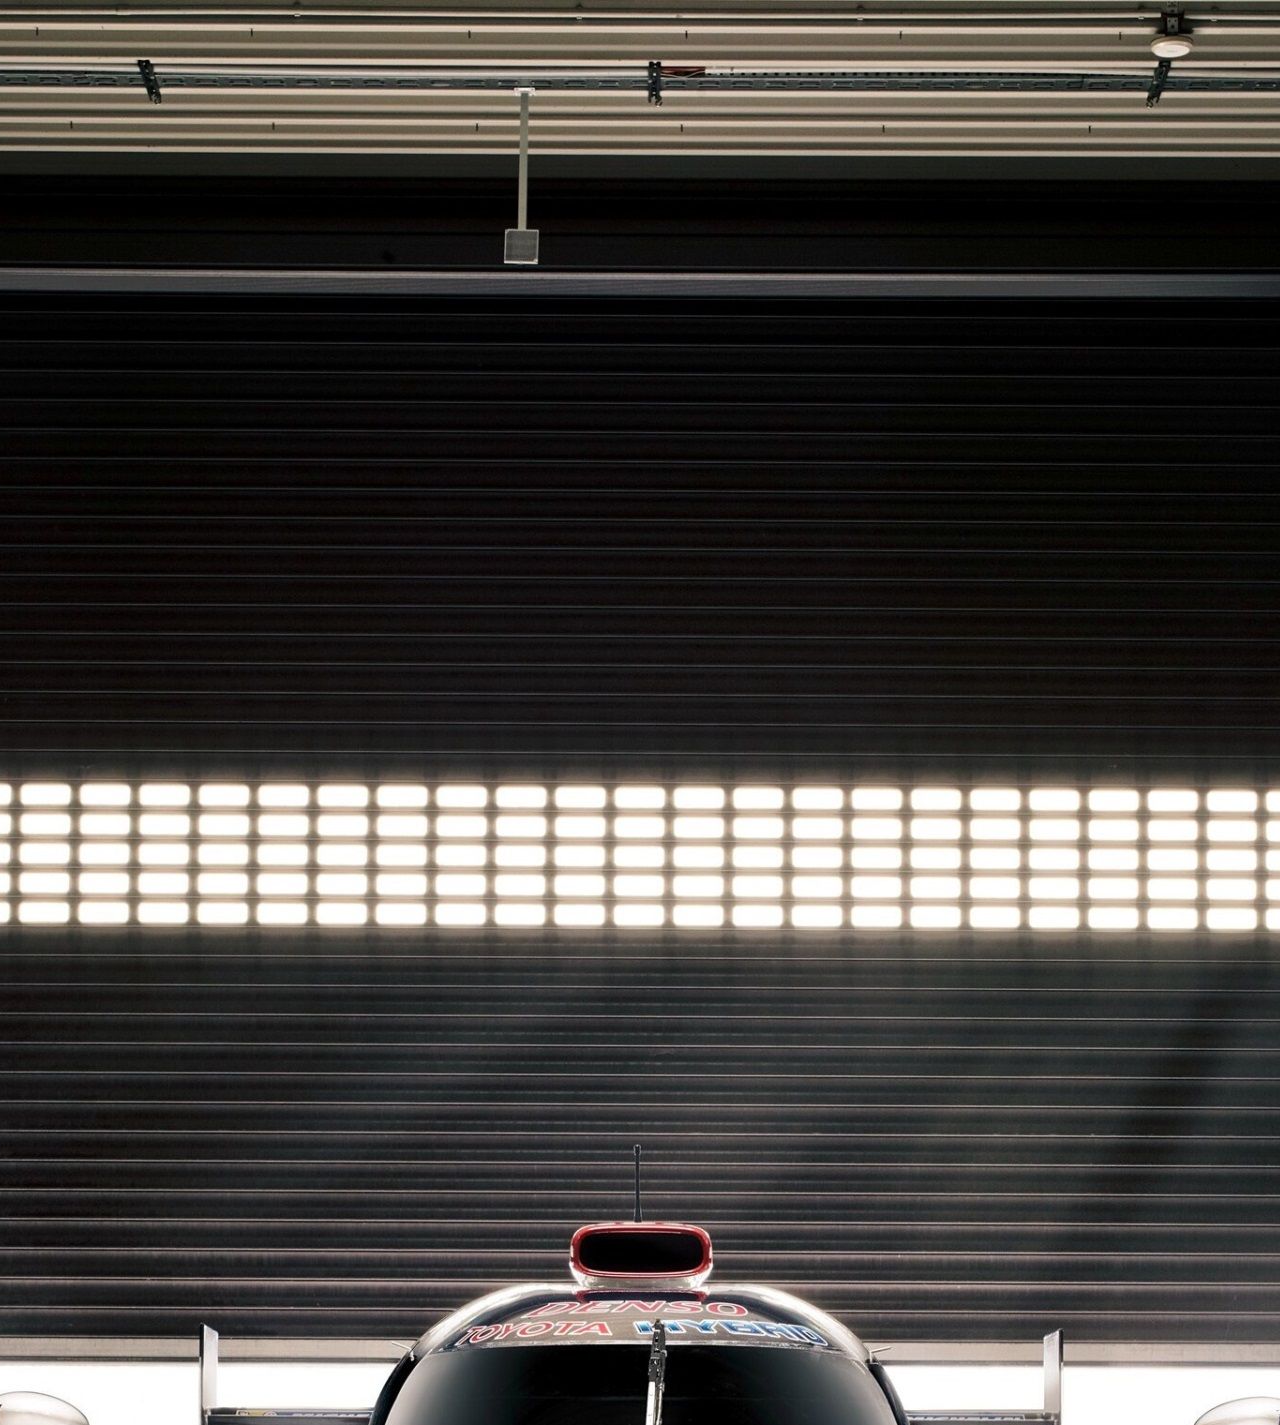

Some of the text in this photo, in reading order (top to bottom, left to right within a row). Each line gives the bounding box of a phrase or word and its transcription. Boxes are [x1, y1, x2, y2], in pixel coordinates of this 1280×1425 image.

[521, 1300, 749, 1319] DENSO
[454, 1318, 829, 1347] TOYOTA HYBRID
